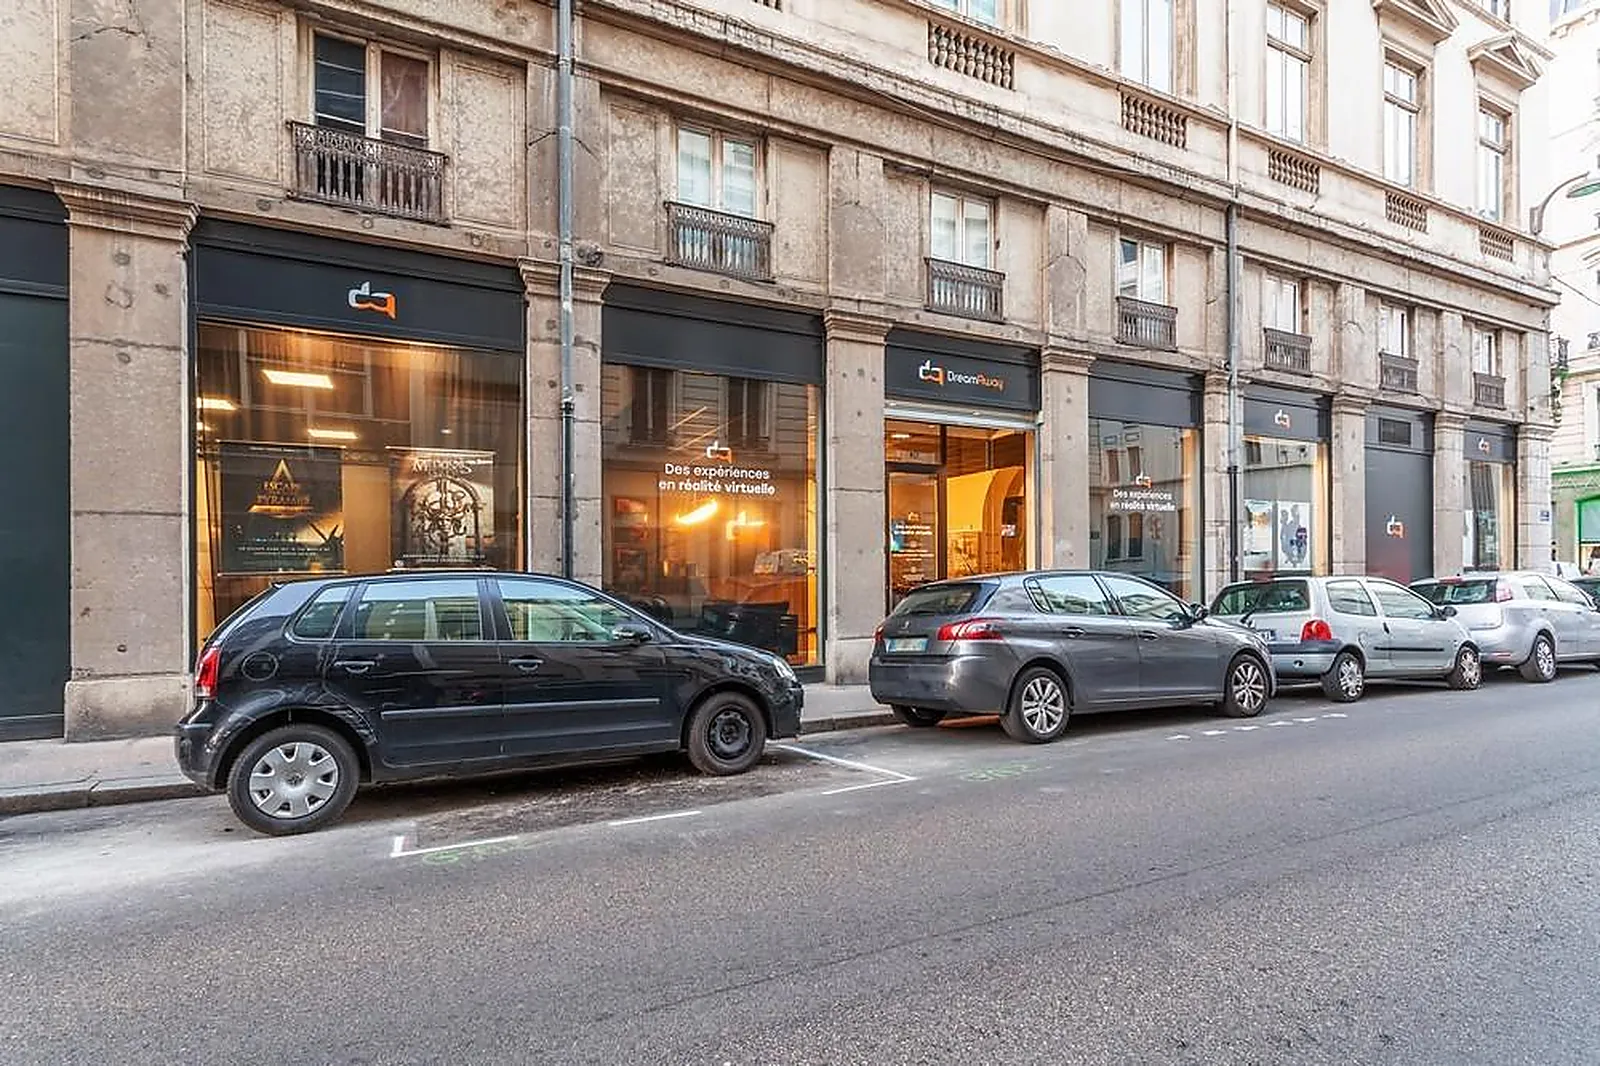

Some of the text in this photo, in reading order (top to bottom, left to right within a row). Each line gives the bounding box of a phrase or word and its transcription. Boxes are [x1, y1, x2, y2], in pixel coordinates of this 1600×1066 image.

[947, 370, 1004, 392] DreamAway
[665, 463, 770, 479] Des expériences
[658, 479, 776, 495] en réalité virtuelle
[1113, 489, 1128, 499] Des
